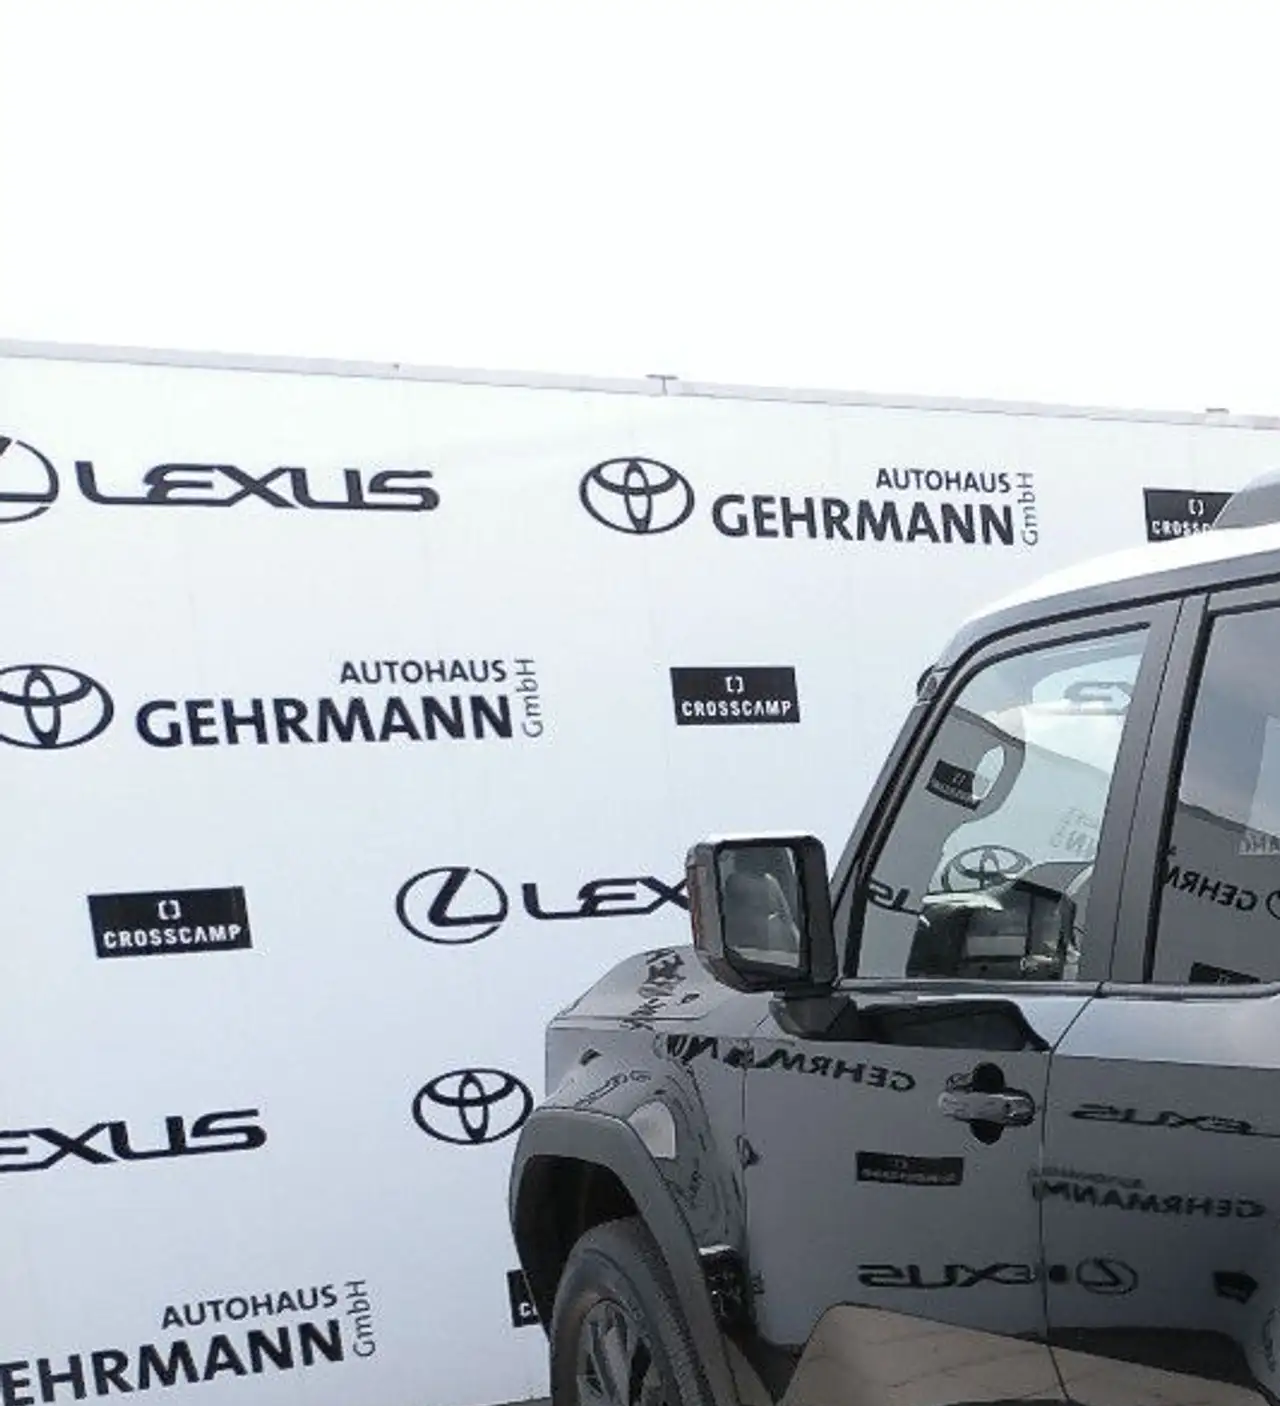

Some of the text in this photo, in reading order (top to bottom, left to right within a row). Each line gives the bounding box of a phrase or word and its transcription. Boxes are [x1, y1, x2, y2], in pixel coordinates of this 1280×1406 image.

[74, 460, 441, 513] LEXUS
[875, 467, 1012, 494] AUTOHAUS
[711, 493, 1015, 546] GEHRMANN
[1020, 472, 1039, 547] GmbH
[339, 659, 508, 685] AUTOHAUS
[515, 658, 544, 739] GmbH
[135, 693, 514, 748] GEHRMANN
[681, 699, 793, 717] CROSSCAMP
[521, 875, 690, 921] LEX
[103, 923, 242, 949] CROSSCAMP
[0, 1108, 267, 1173] EXUS
[161, 1283, 338, 1330] AUTOHAUS
[347, 1279, 376, 1358] GmbH
